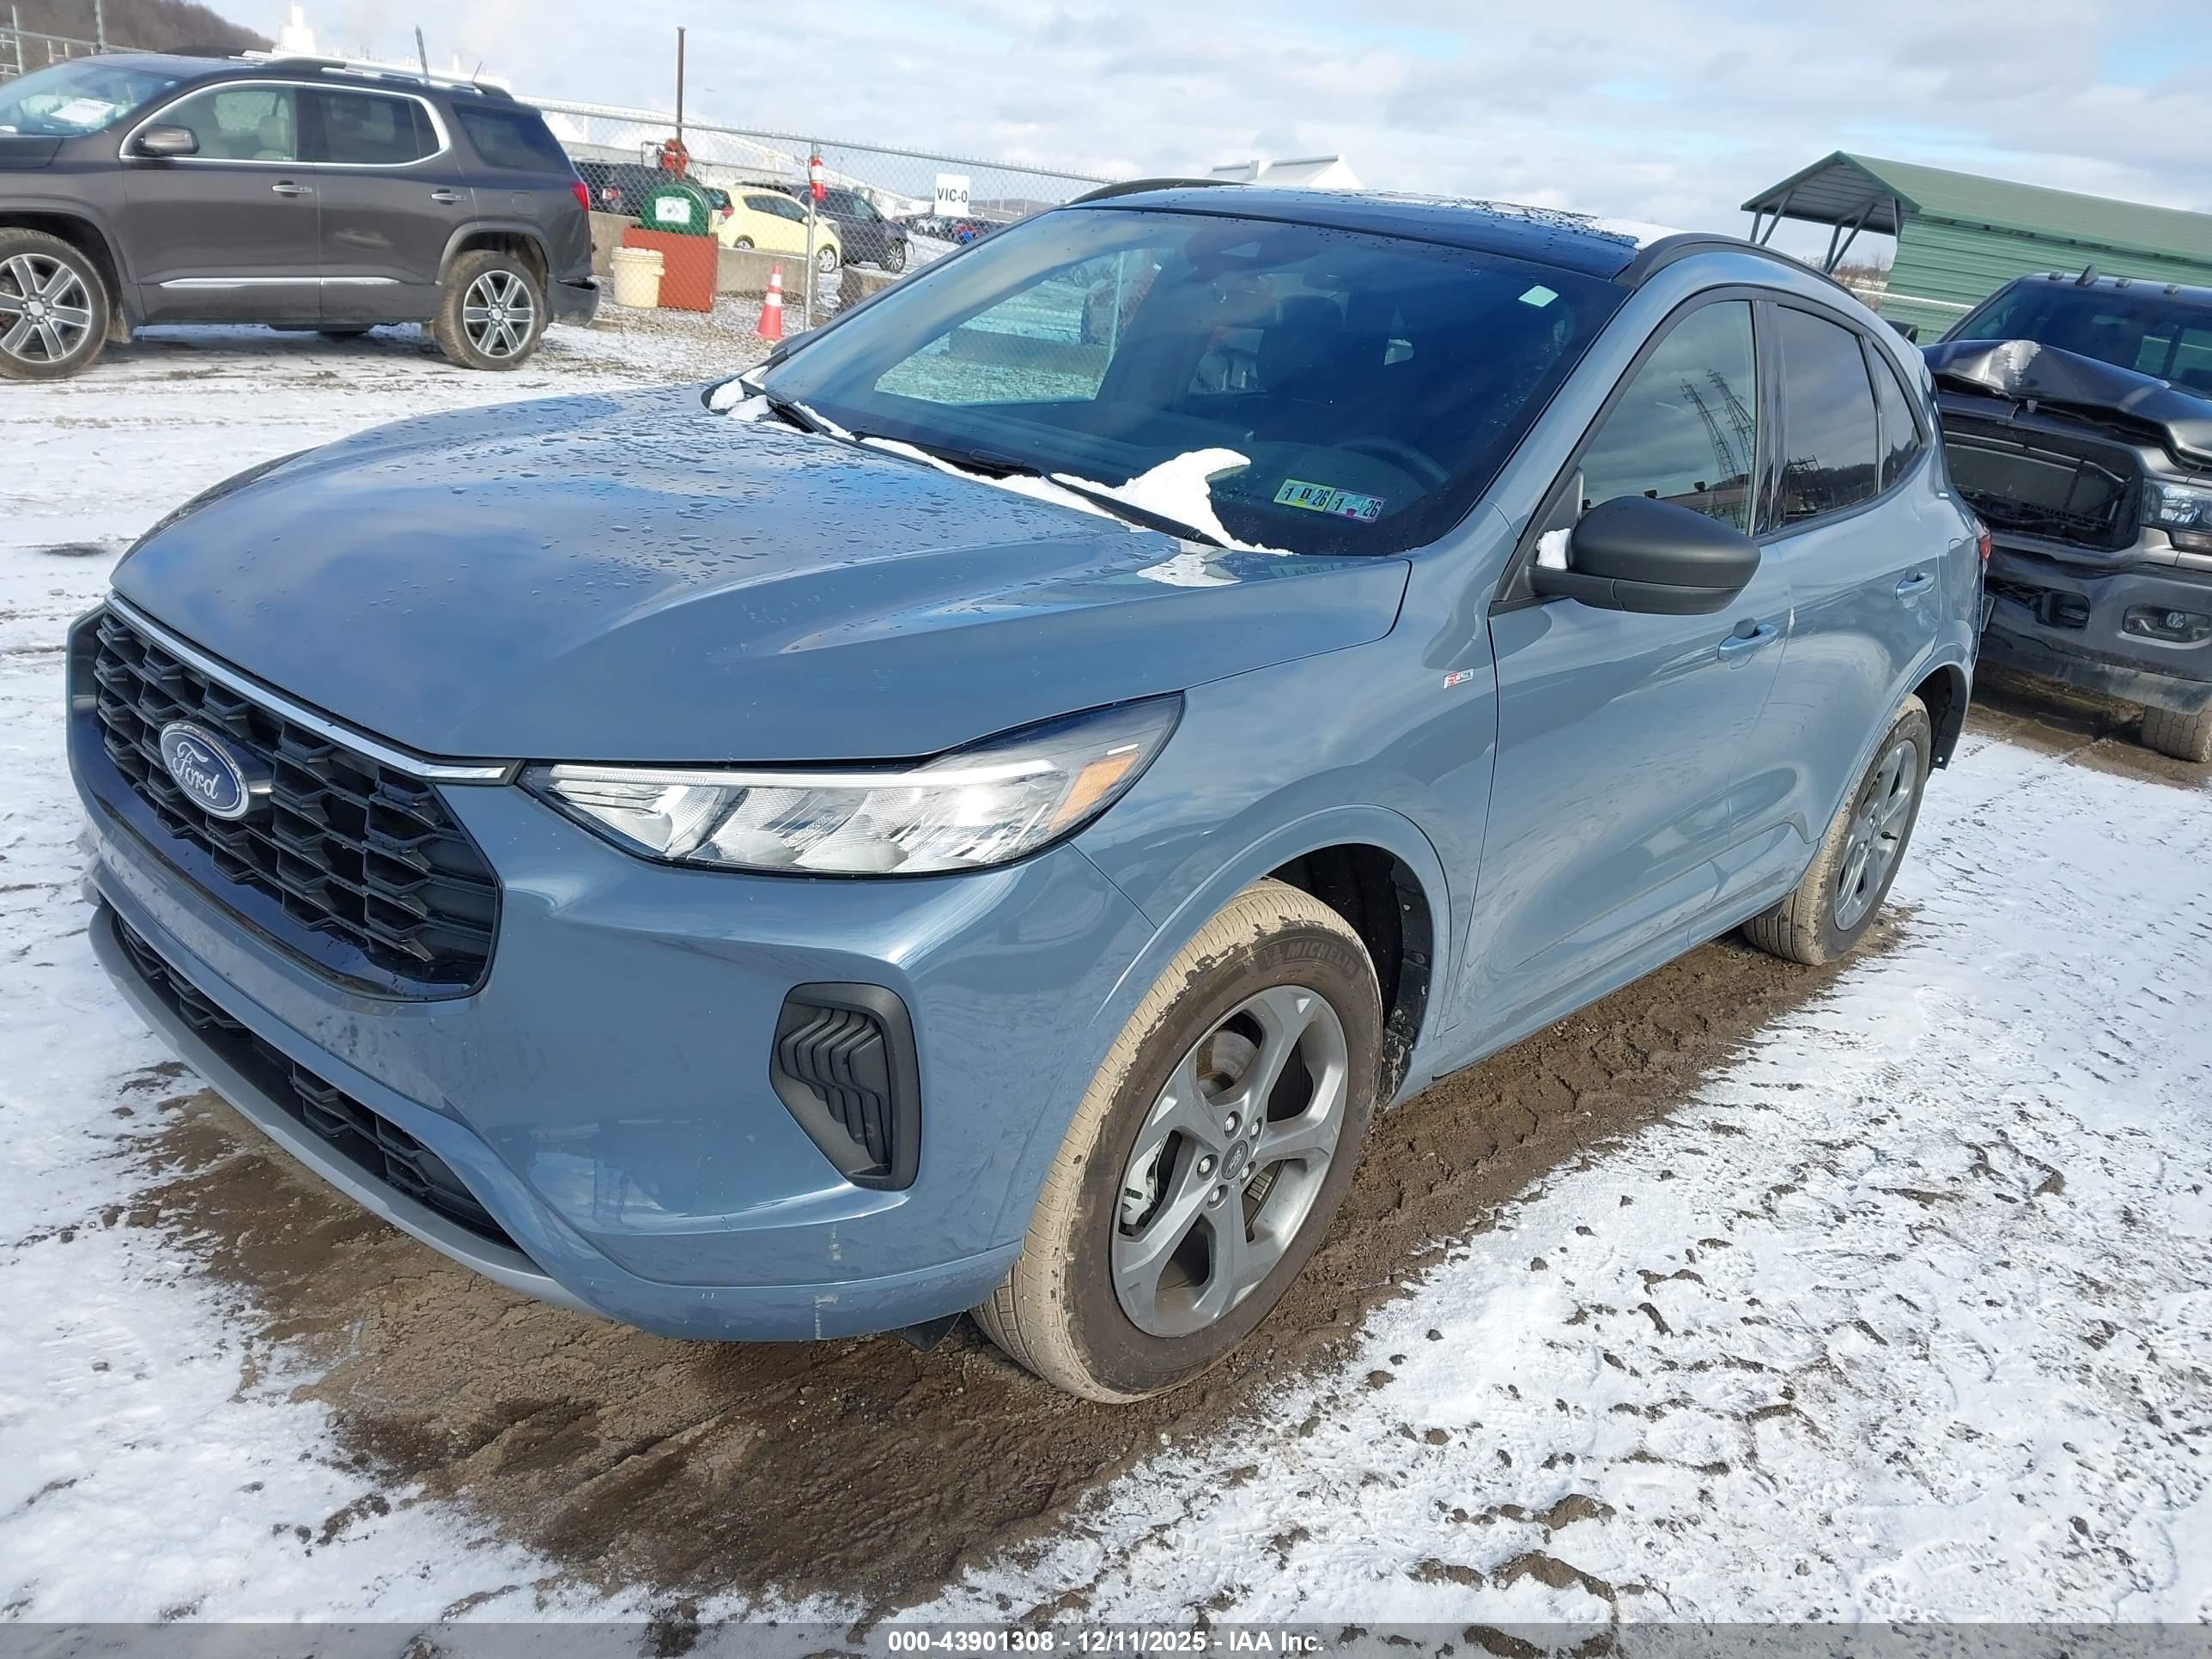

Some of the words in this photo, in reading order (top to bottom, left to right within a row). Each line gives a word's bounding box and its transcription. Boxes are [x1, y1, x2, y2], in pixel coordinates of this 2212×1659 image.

[1285, 487, 1294, 501] 1
[1312, 489, 1330, 507] 26
[1334, 497, 1344, 511] 1
[1364, 500, 1381, 517] 26
[173, 741, 220, 799] Ford
[1286, 942, 1358, 976] MICHELIN
